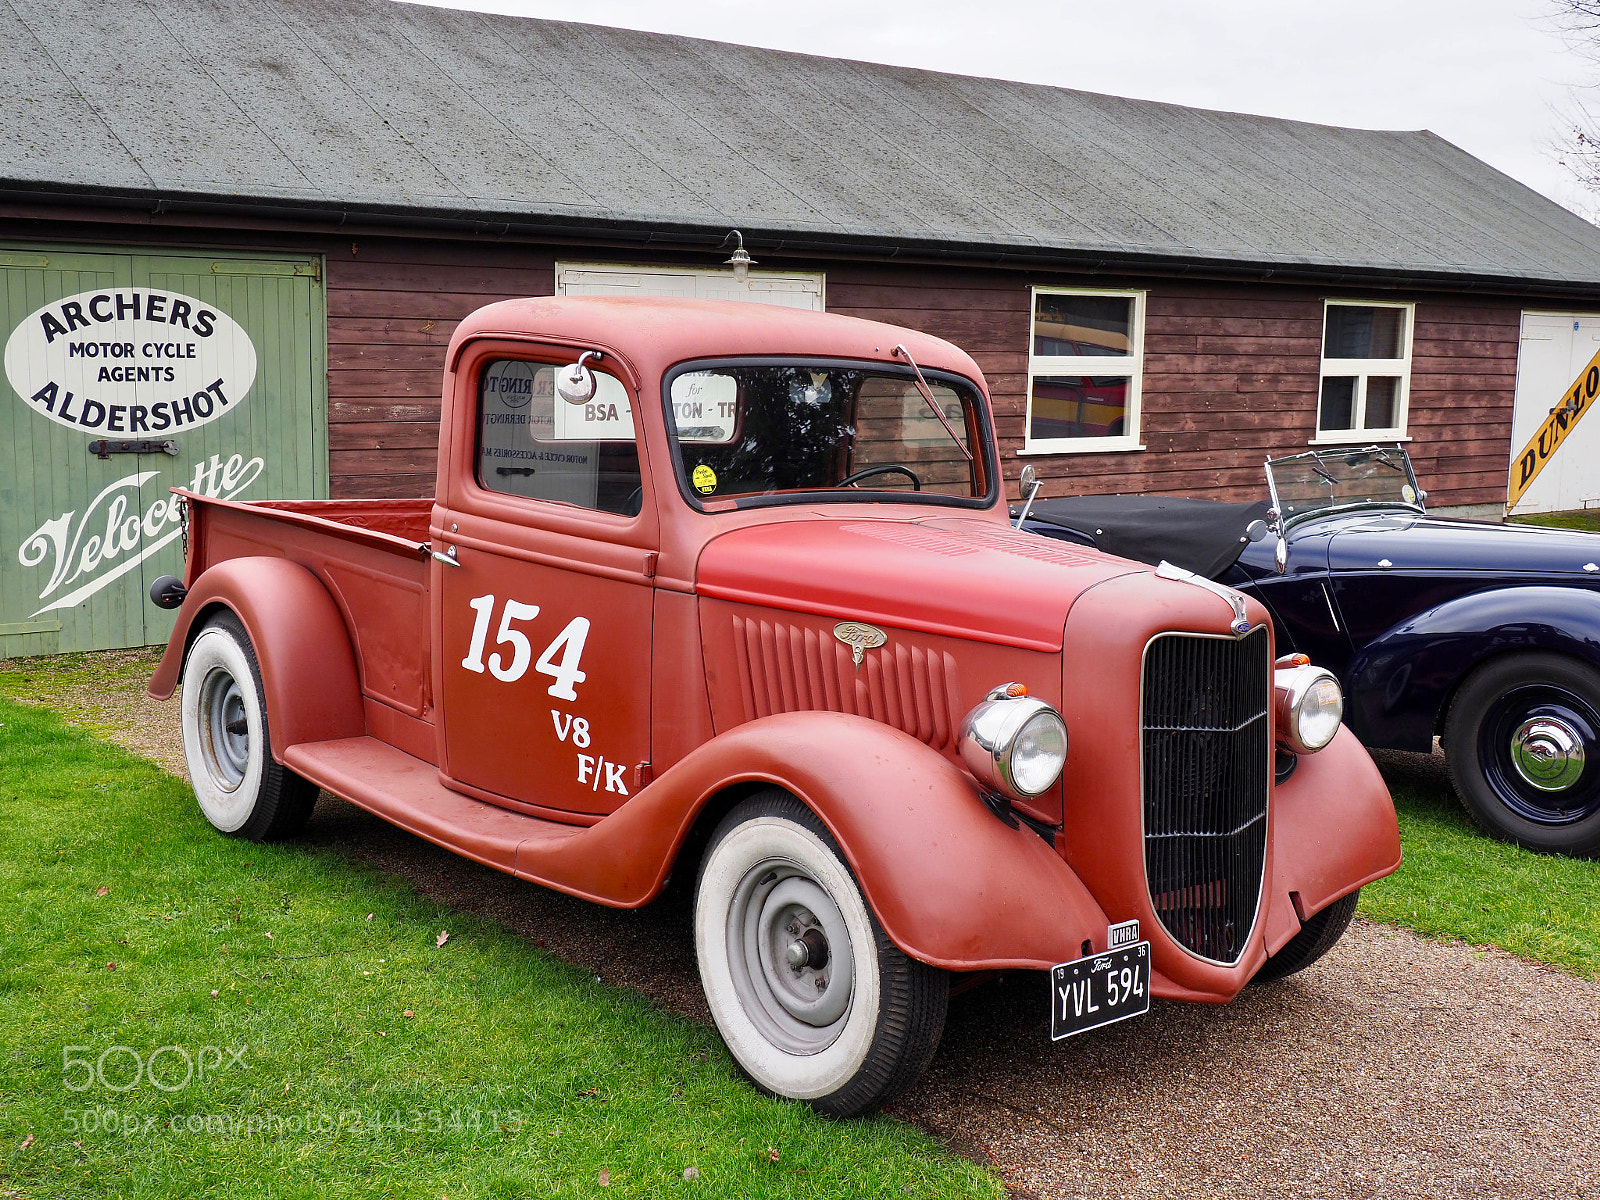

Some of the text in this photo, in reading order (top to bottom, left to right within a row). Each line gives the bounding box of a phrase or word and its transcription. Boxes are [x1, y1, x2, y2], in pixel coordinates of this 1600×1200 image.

[40, 293, 217, 343] ARCHERS
[69, 342, 196, 359] MOTOR CYCLE
[98, 366, 175, 382] AGENTS
[685, 383, 703, 398] for
[31, 378, 229, 433] ALDERSHOT
[585, 403, 619, 422] BSA
[1519, 366, 1599, 490] DUNLO
[18, 453, 264, 599] Velocette
[461, 594, 591, 701] 154
[840, 625, 879, 645] Ford
[551, 709, 591, 749] V8
[576, 752, 629, 795] F/K
[1113, 925, 1138, 944] VHRA
[1057, 945, 1146, 980] 19 Ford 36
[1058, 964, 1144, 1021] YVL 594
